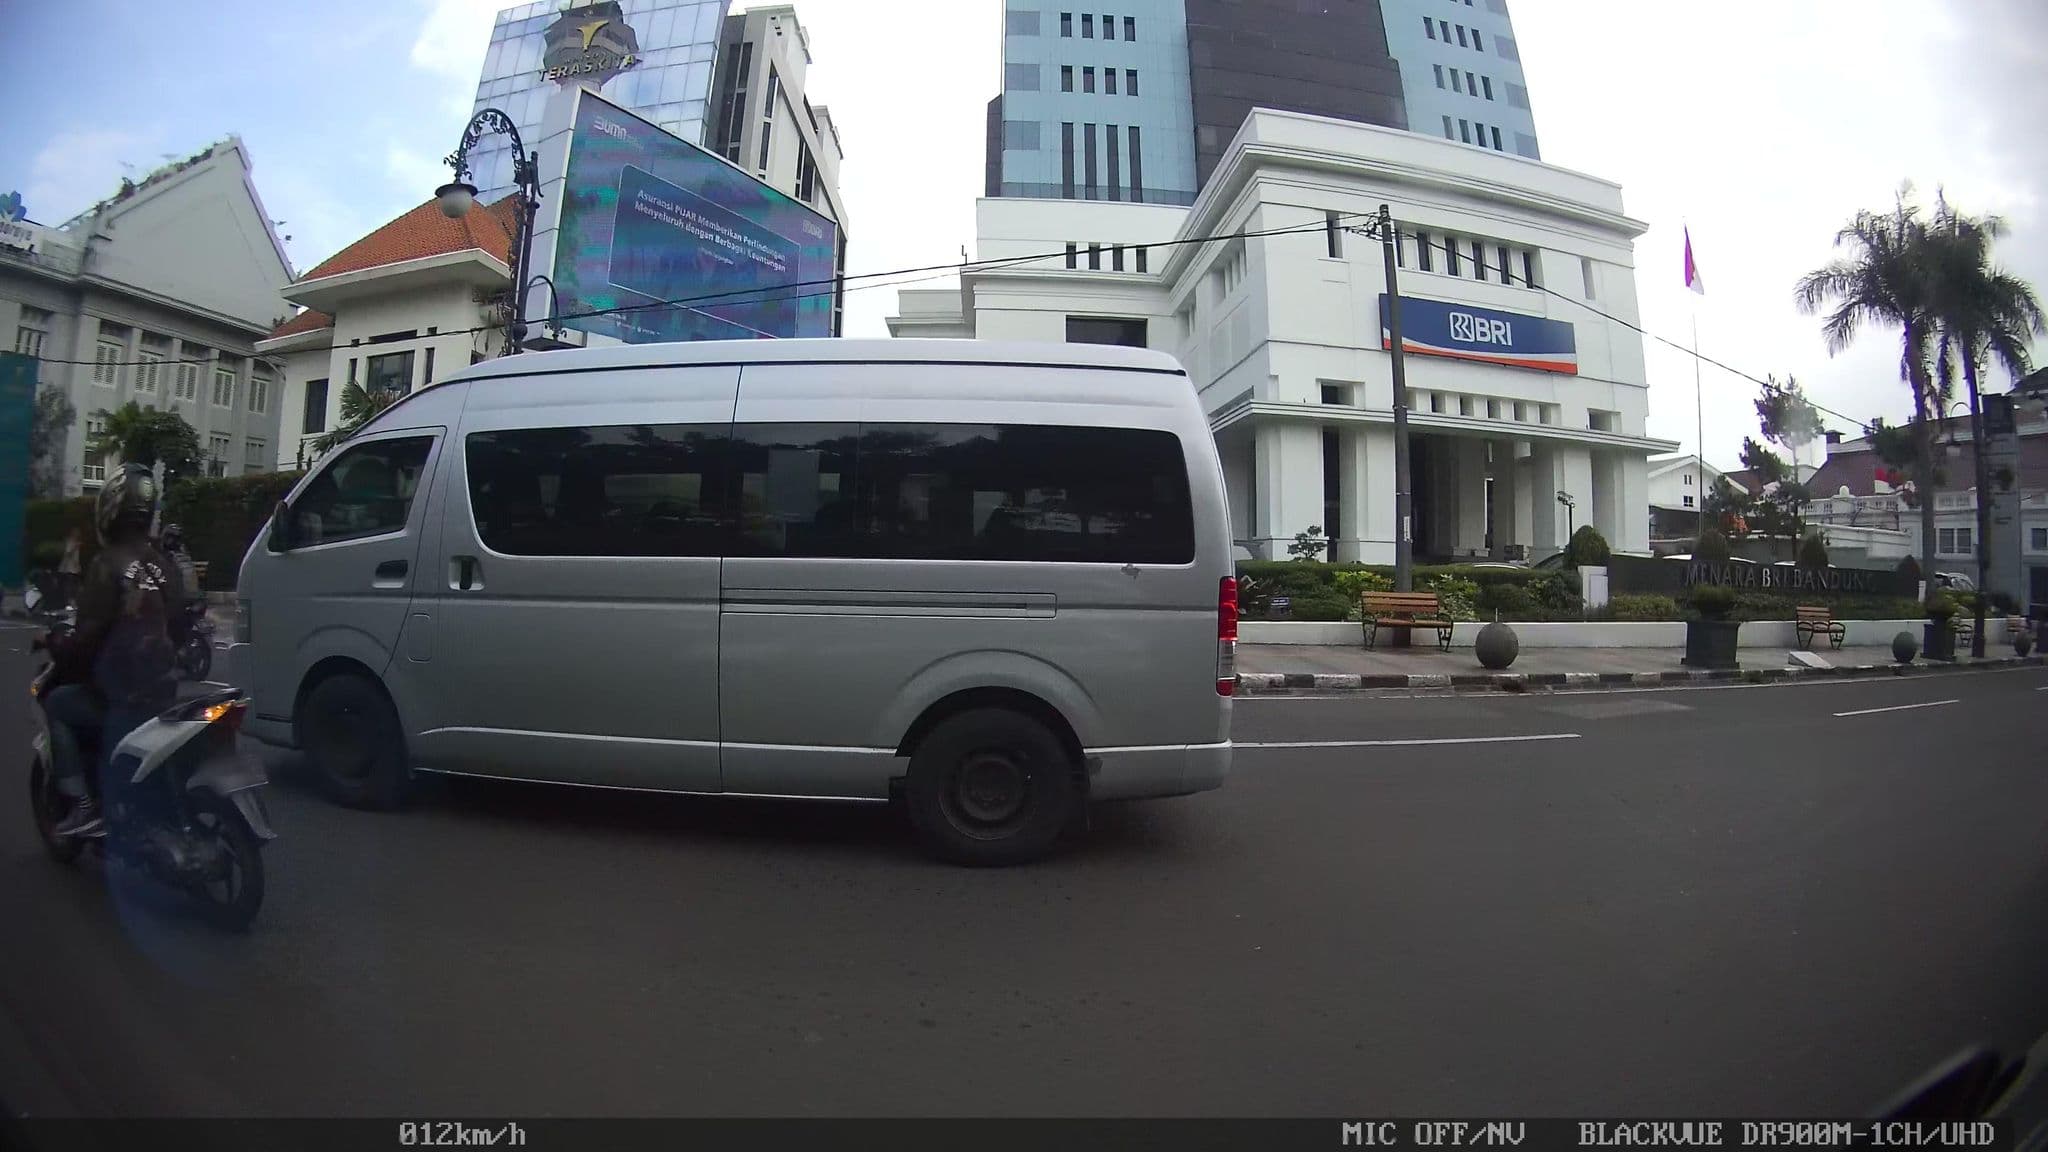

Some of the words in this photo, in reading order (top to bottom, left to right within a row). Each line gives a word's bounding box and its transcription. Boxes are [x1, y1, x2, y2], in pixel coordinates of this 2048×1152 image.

[634, 200, 684, 228] Menyeluruh
[685, 222, 714, 240] dengan
[637, 189, 674, 211] Asuransi
[697, 215, 742, 242] Memberikan
[1474, 317, 1513, 346] BRI
[1685, 563, 1756, 587] MENARA
[1762, 567, 1789, 588] BRI
